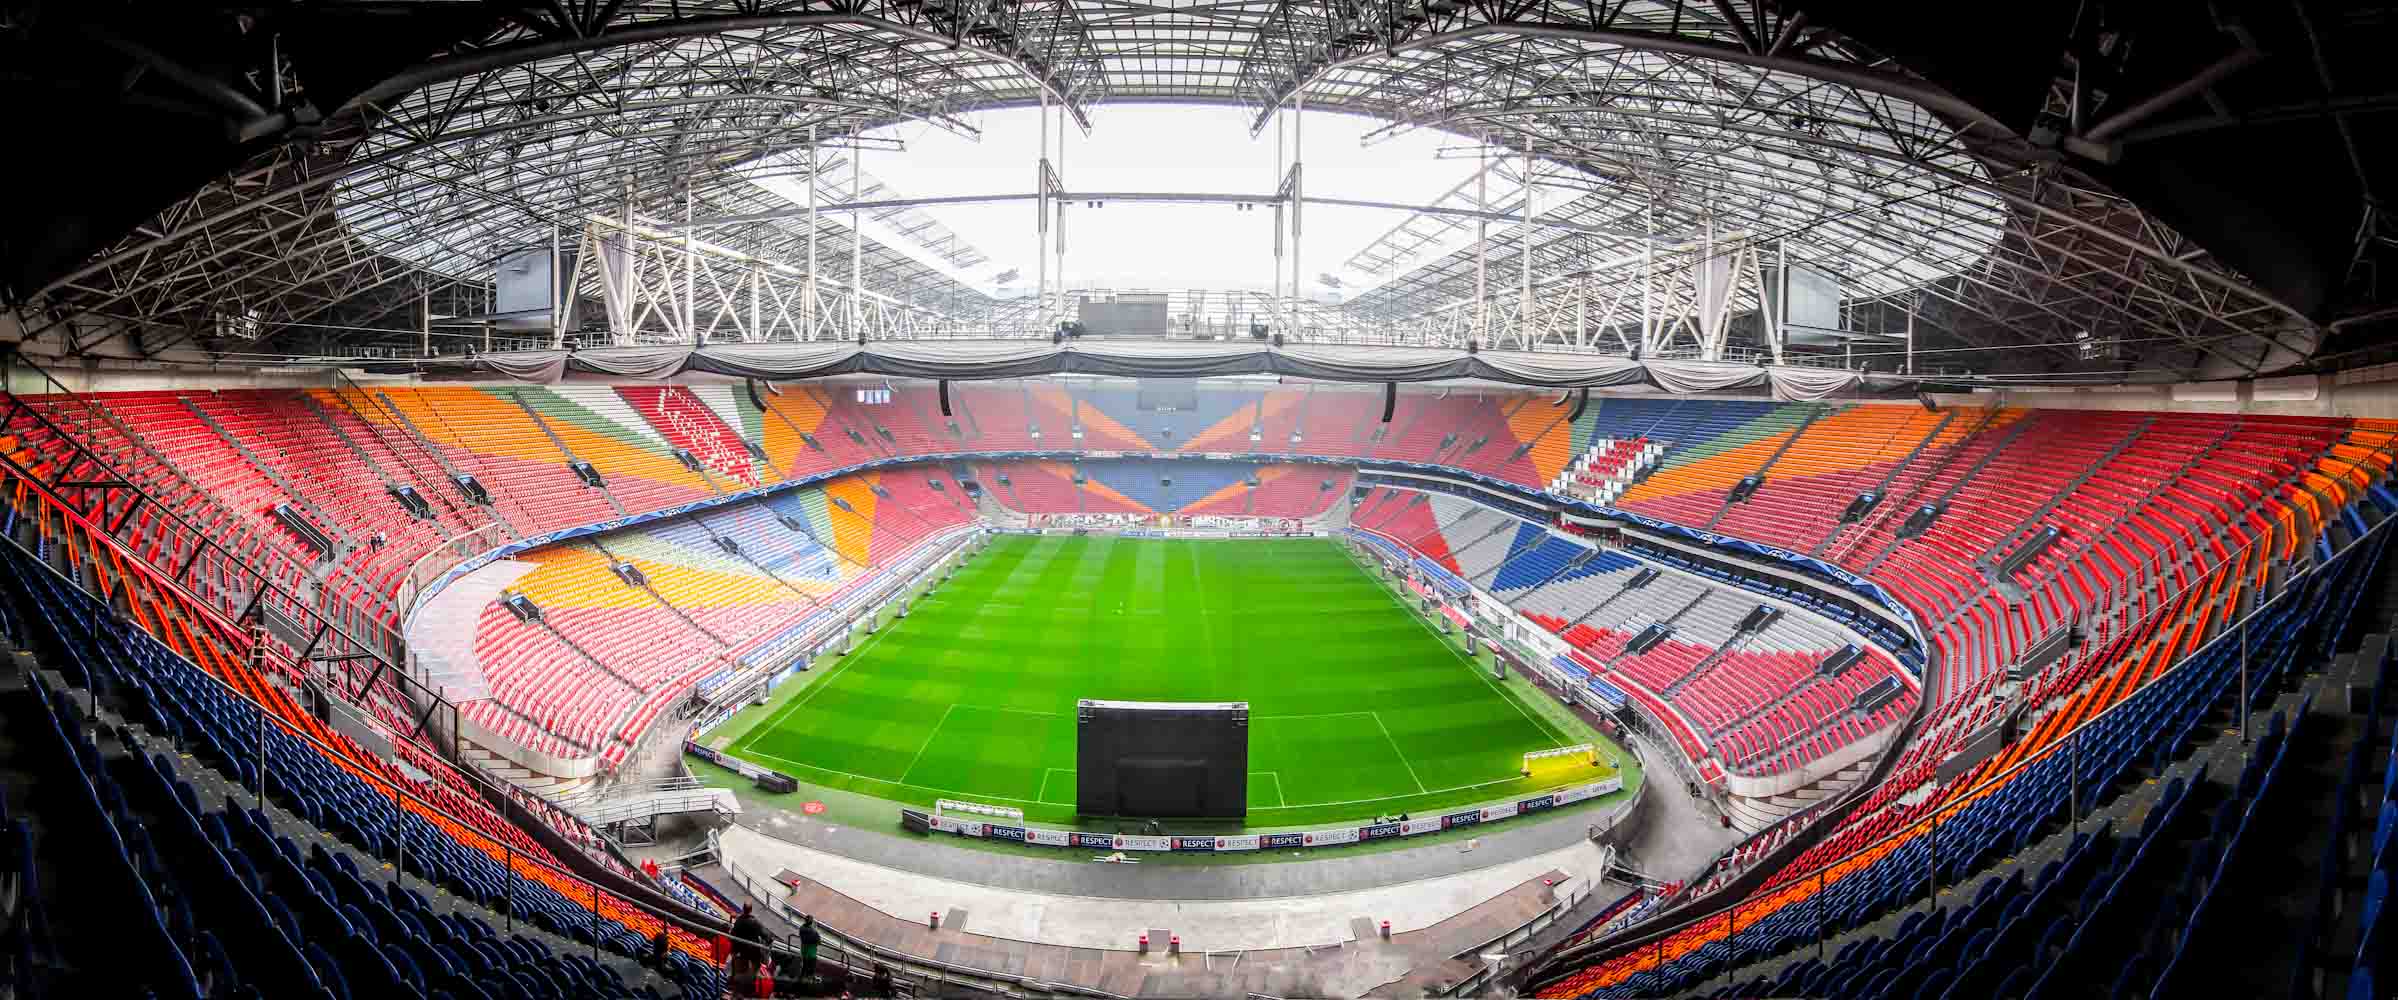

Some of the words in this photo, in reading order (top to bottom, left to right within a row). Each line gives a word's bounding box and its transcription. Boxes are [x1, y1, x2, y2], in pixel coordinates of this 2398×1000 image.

[694, 746, 714, 758] RESPECT
[1527, 797, 1553, 809] RESPECT
[1451, 812, 1480, 824] RESPECT
[993, 828, 1024, 839] RESPECT
[1370, 826, 1400, 836] RESPECT
[1036, 833, 1068, 843] RESPECT
[1080, 836, 1113, 845] RESPECT
[1182, 839, 1215, 848] RESPECT
[1271, 835, 1302, 846] RESPECT
